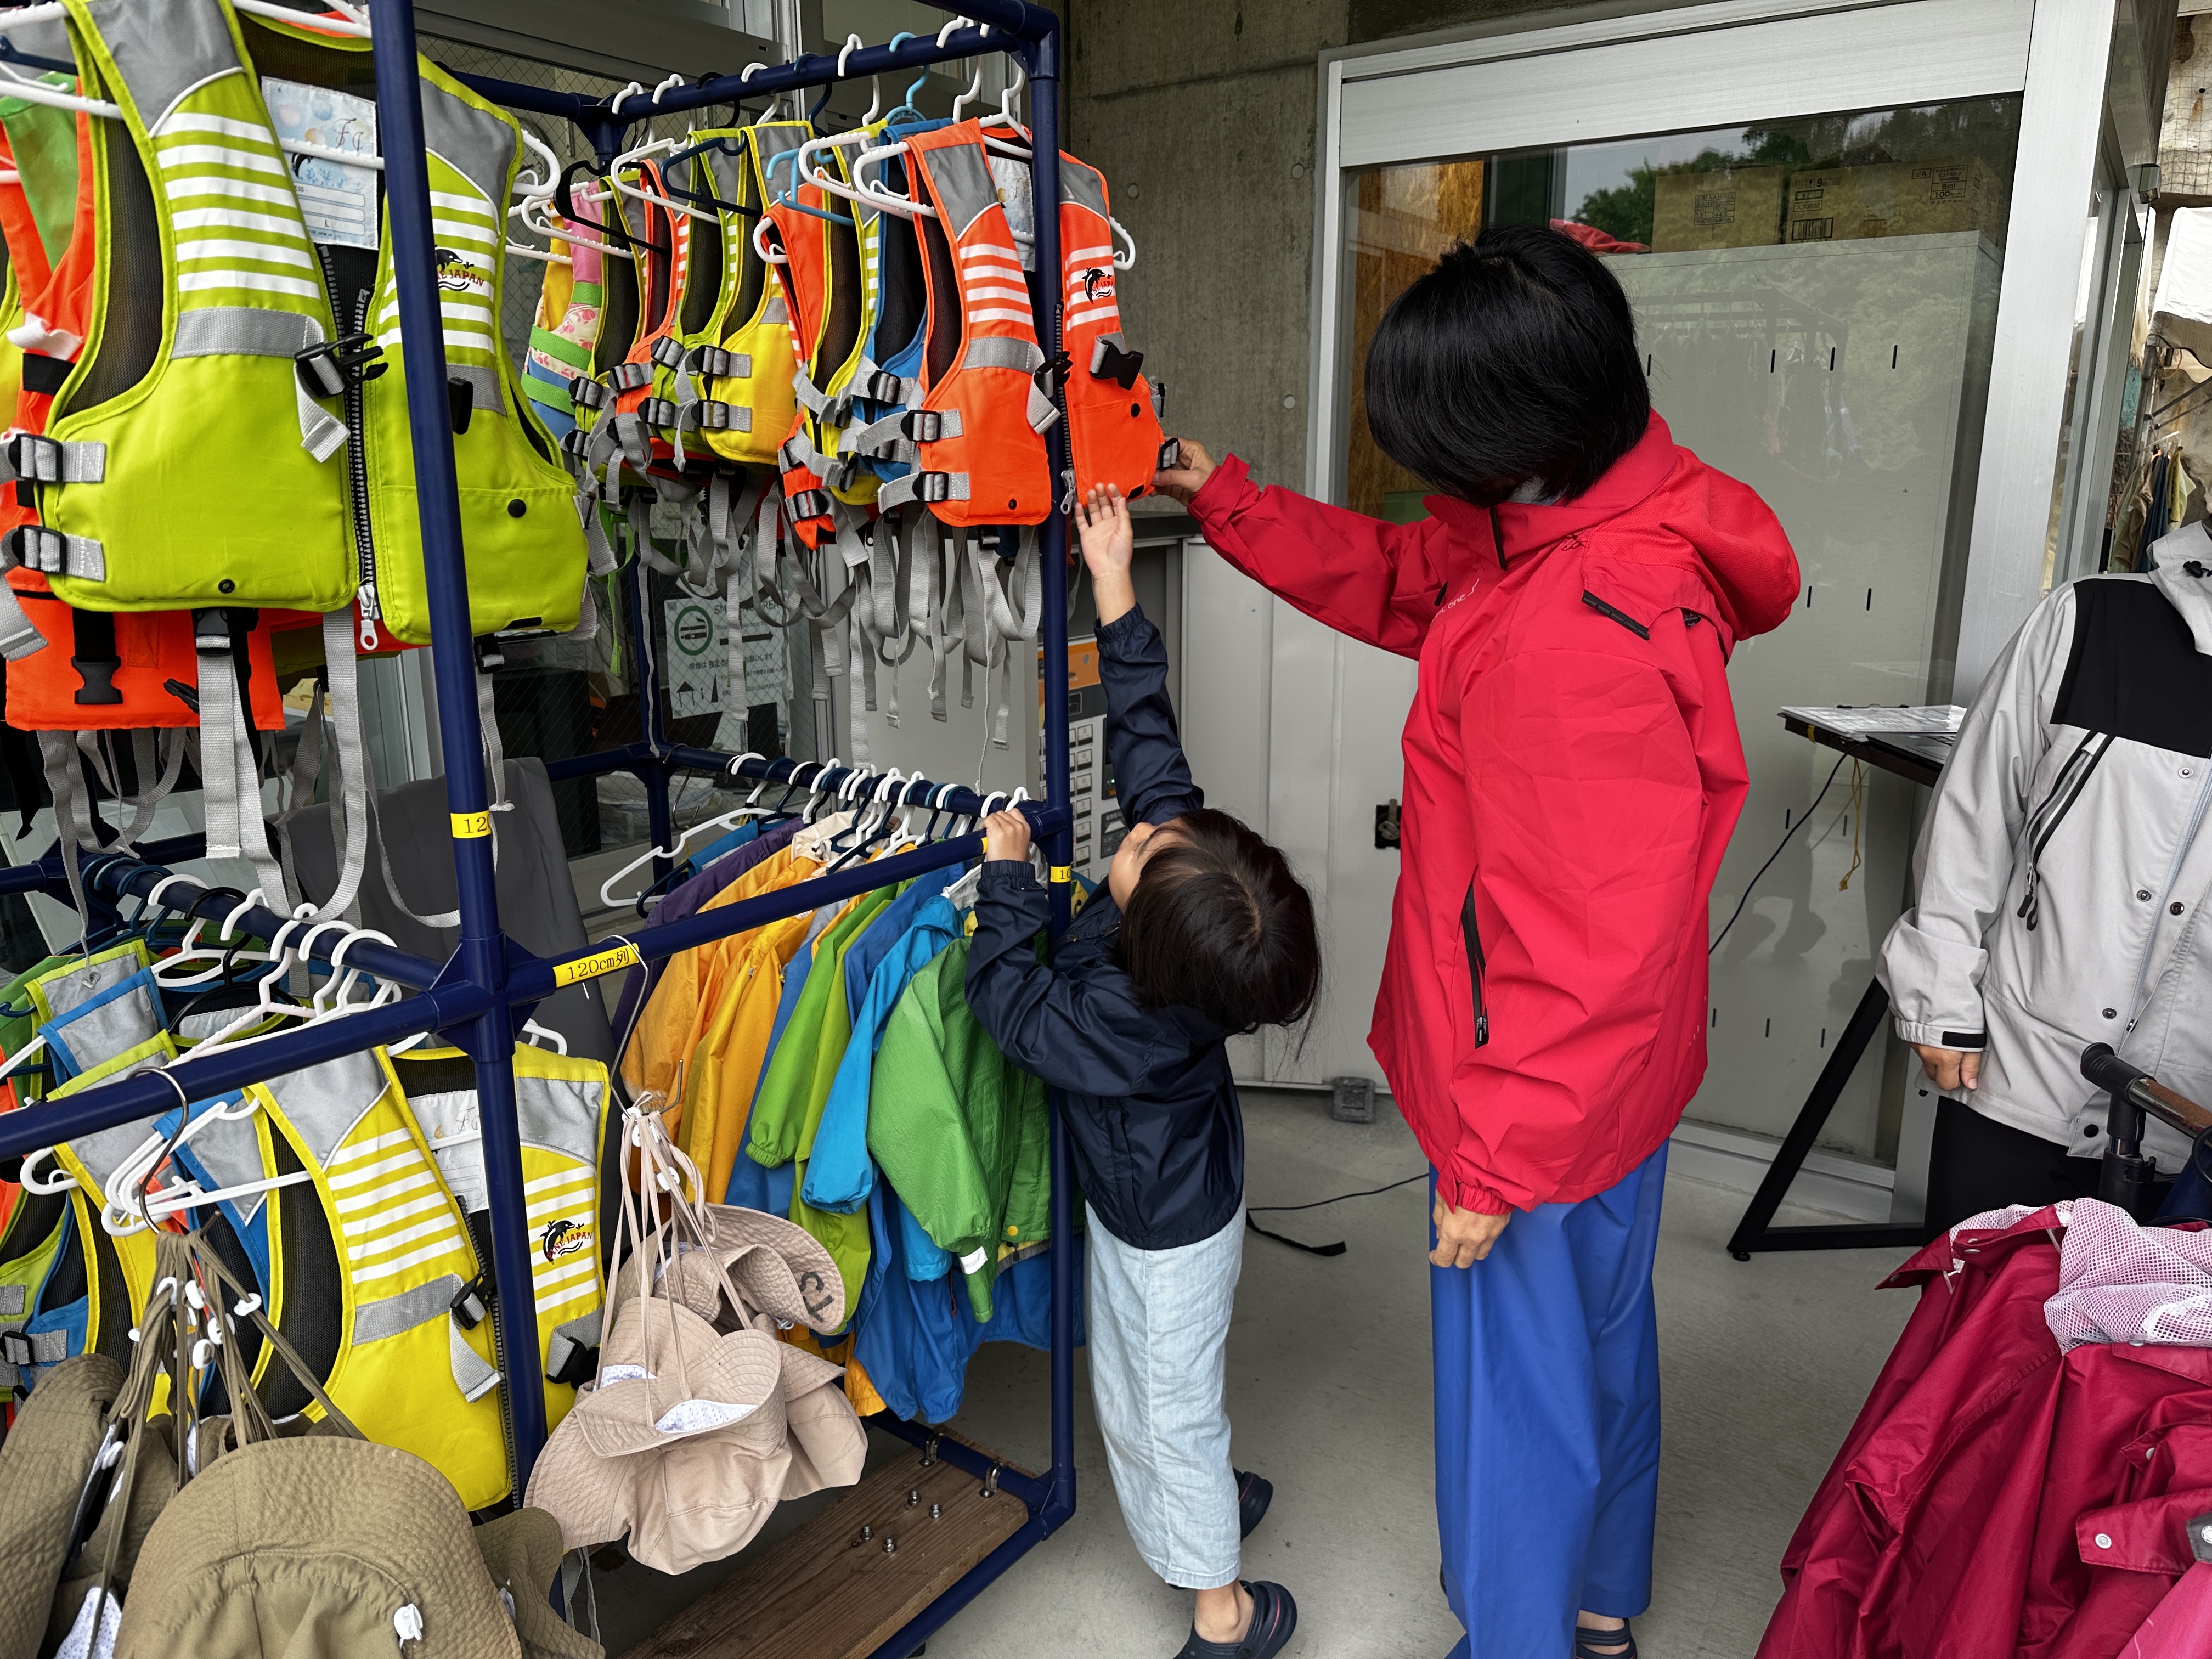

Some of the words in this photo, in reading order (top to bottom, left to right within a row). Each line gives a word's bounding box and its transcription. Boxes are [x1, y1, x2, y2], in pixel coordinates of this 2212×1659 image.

[324, 219, 330, 228] L
[448, 269, 485, 287] JAPAN
[763, 600, 779, 610] REA
[567, 947, 630, 981] 120cm列
[566, 1231, 593, 1244] JAPAN
